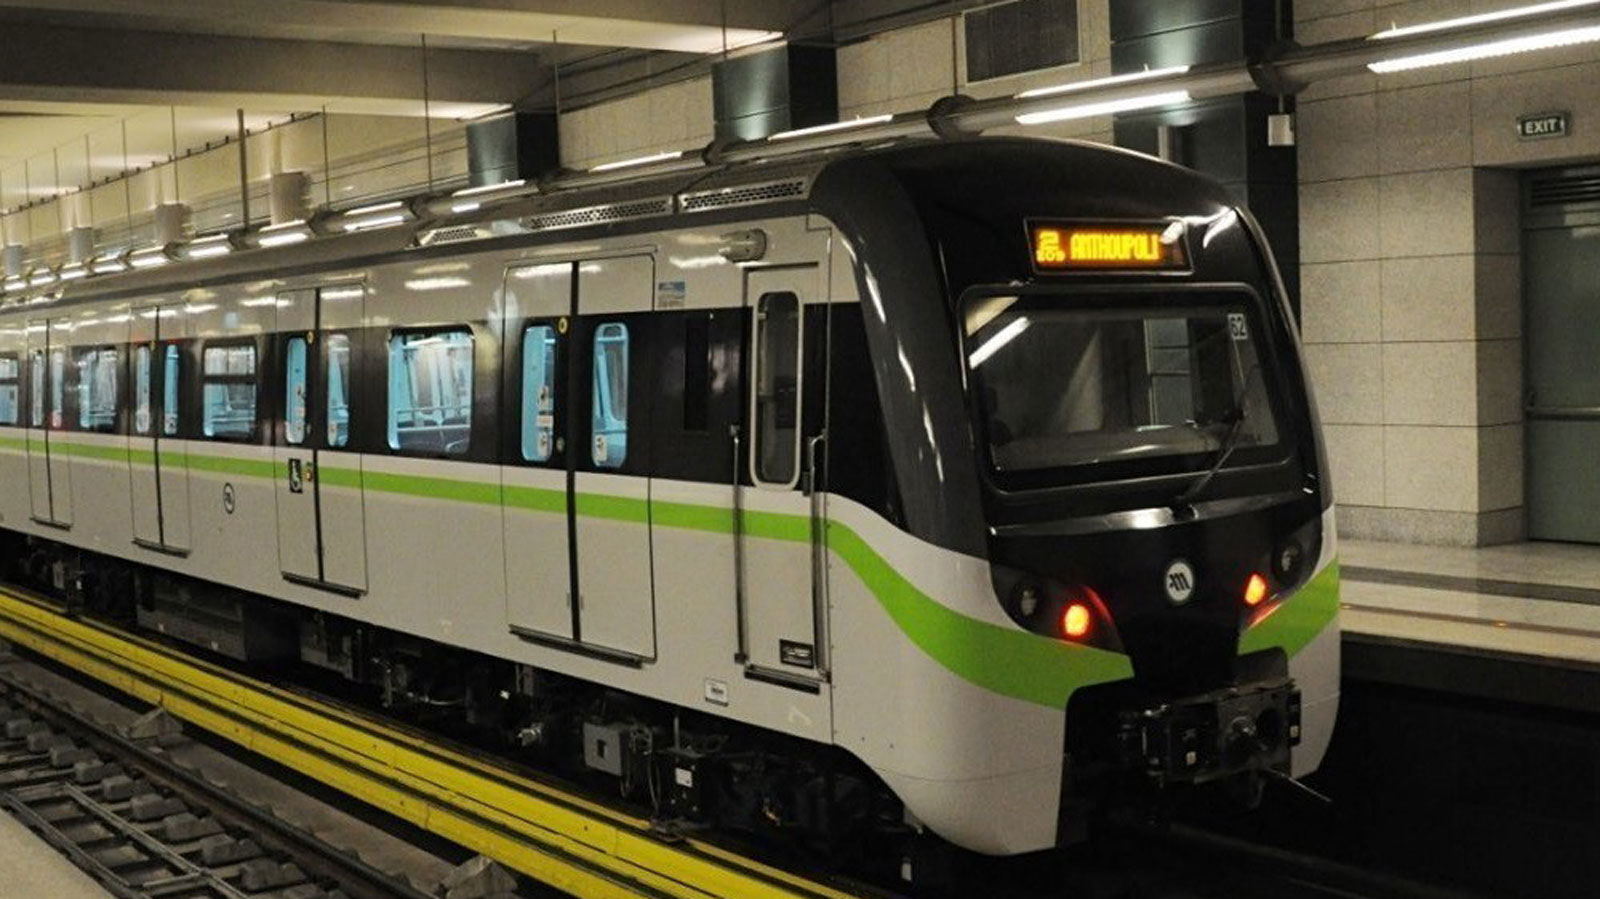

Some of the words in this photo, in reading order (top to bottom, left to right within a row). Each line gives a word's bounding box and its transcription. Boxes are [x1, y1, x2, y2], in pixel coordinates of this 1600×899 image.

[1525, 118, 1557, 134] EXIT
[1070, 233, 1160, 261] ANTHOUPOLI
[1230, 316, 1246, 337] 62
